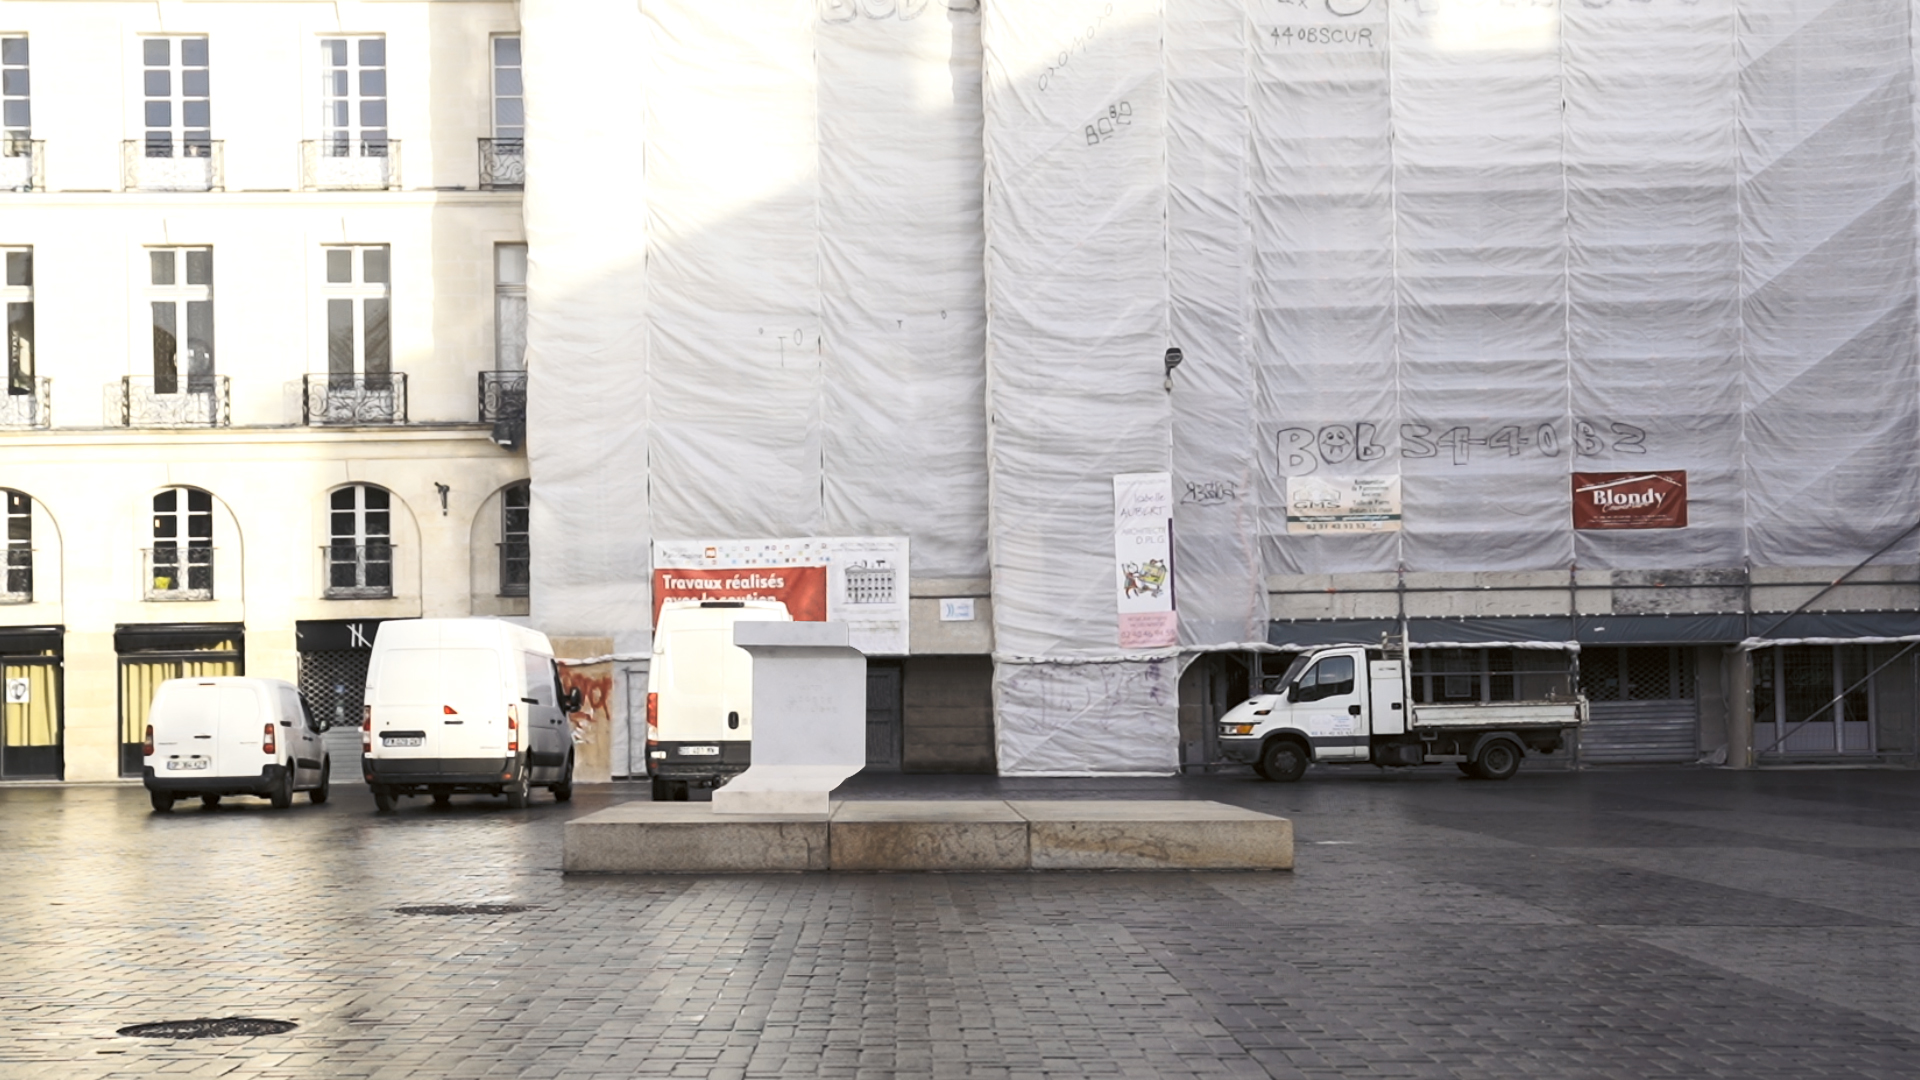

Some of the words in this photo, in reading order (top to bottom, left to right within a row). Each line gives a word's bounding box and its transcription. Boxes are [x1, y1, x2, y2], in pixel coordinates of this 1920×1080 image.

[1593, 488, 1666, 508] Blondy
[662, 574, 722, 590] Travaux
[725, 572, 784, 589] réalisés
